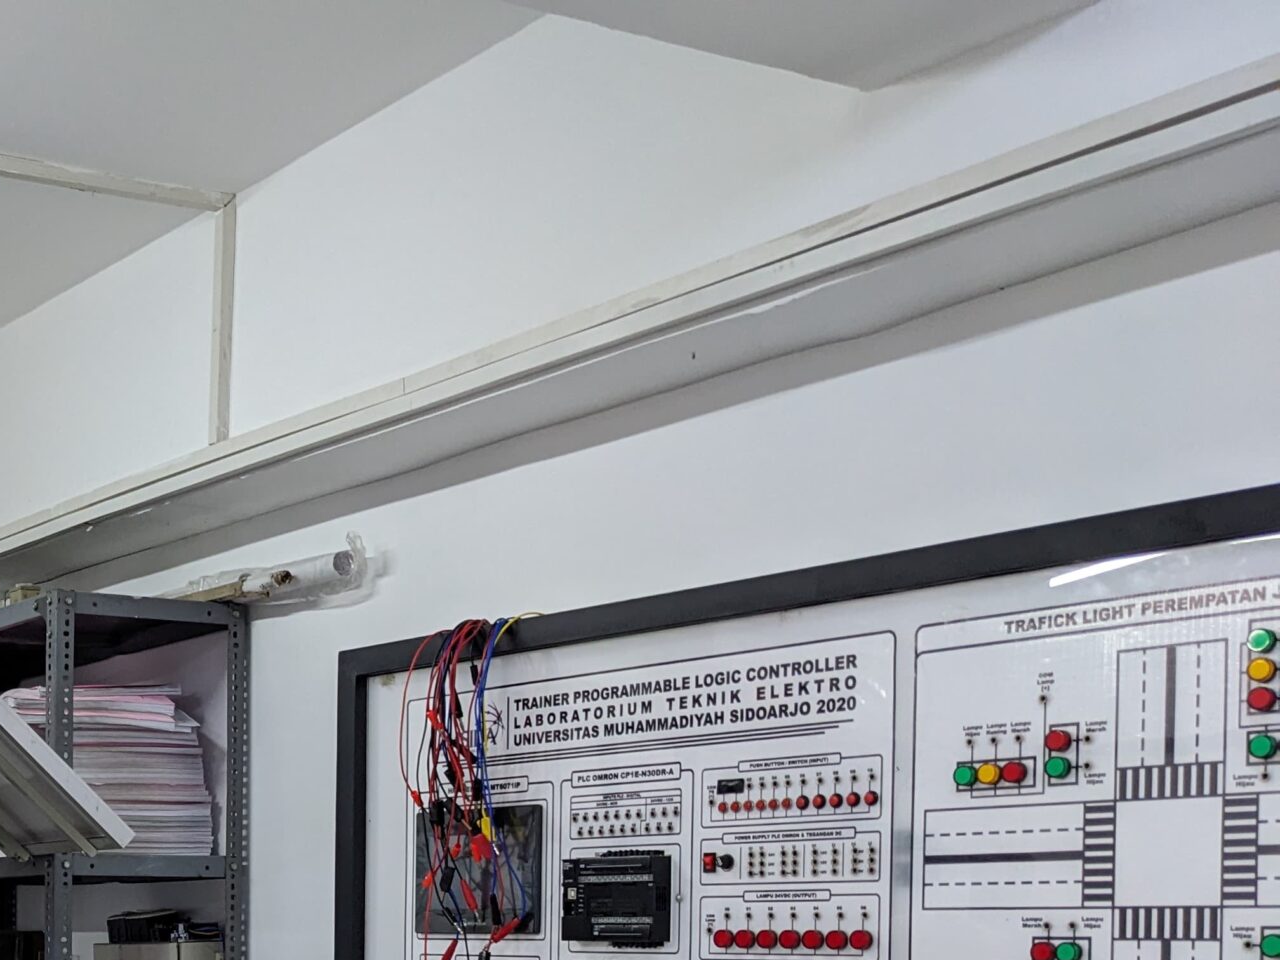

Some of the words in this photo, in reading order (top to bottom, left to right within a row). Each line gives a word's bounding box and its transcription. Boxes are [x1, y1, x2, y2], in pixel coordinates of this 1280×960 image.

[1004, 613, 1078, 634] TRAFICK
[1082, 605, 1136, 625] LIGHT
[1140, 586, 1267, 617] PEREMPATAN
[514, 693, 569, 712] TRAINER
[574, 676, 690, 703] PROGRAMMABLE
[695, 670, 741, 689] LOGIC
[746, 654, 857, 682] CONTROLLER
[514, 700, 652, 729] LABORATORIUM
[666, 690, 741, 711] TEKNIK
[756, 675, 857, 700] ELEKTRO
[514, 725, 599, 747] UNIVERSITAS
[604, 712, 724, 740] MUHAMMADIYAH
[729, 702, 810, 723] SIDOARJO
[816, 696, 856, 715] 2020
[577, 775, 591, 783] PLC
[592, 773, 619, 781] OMRON
